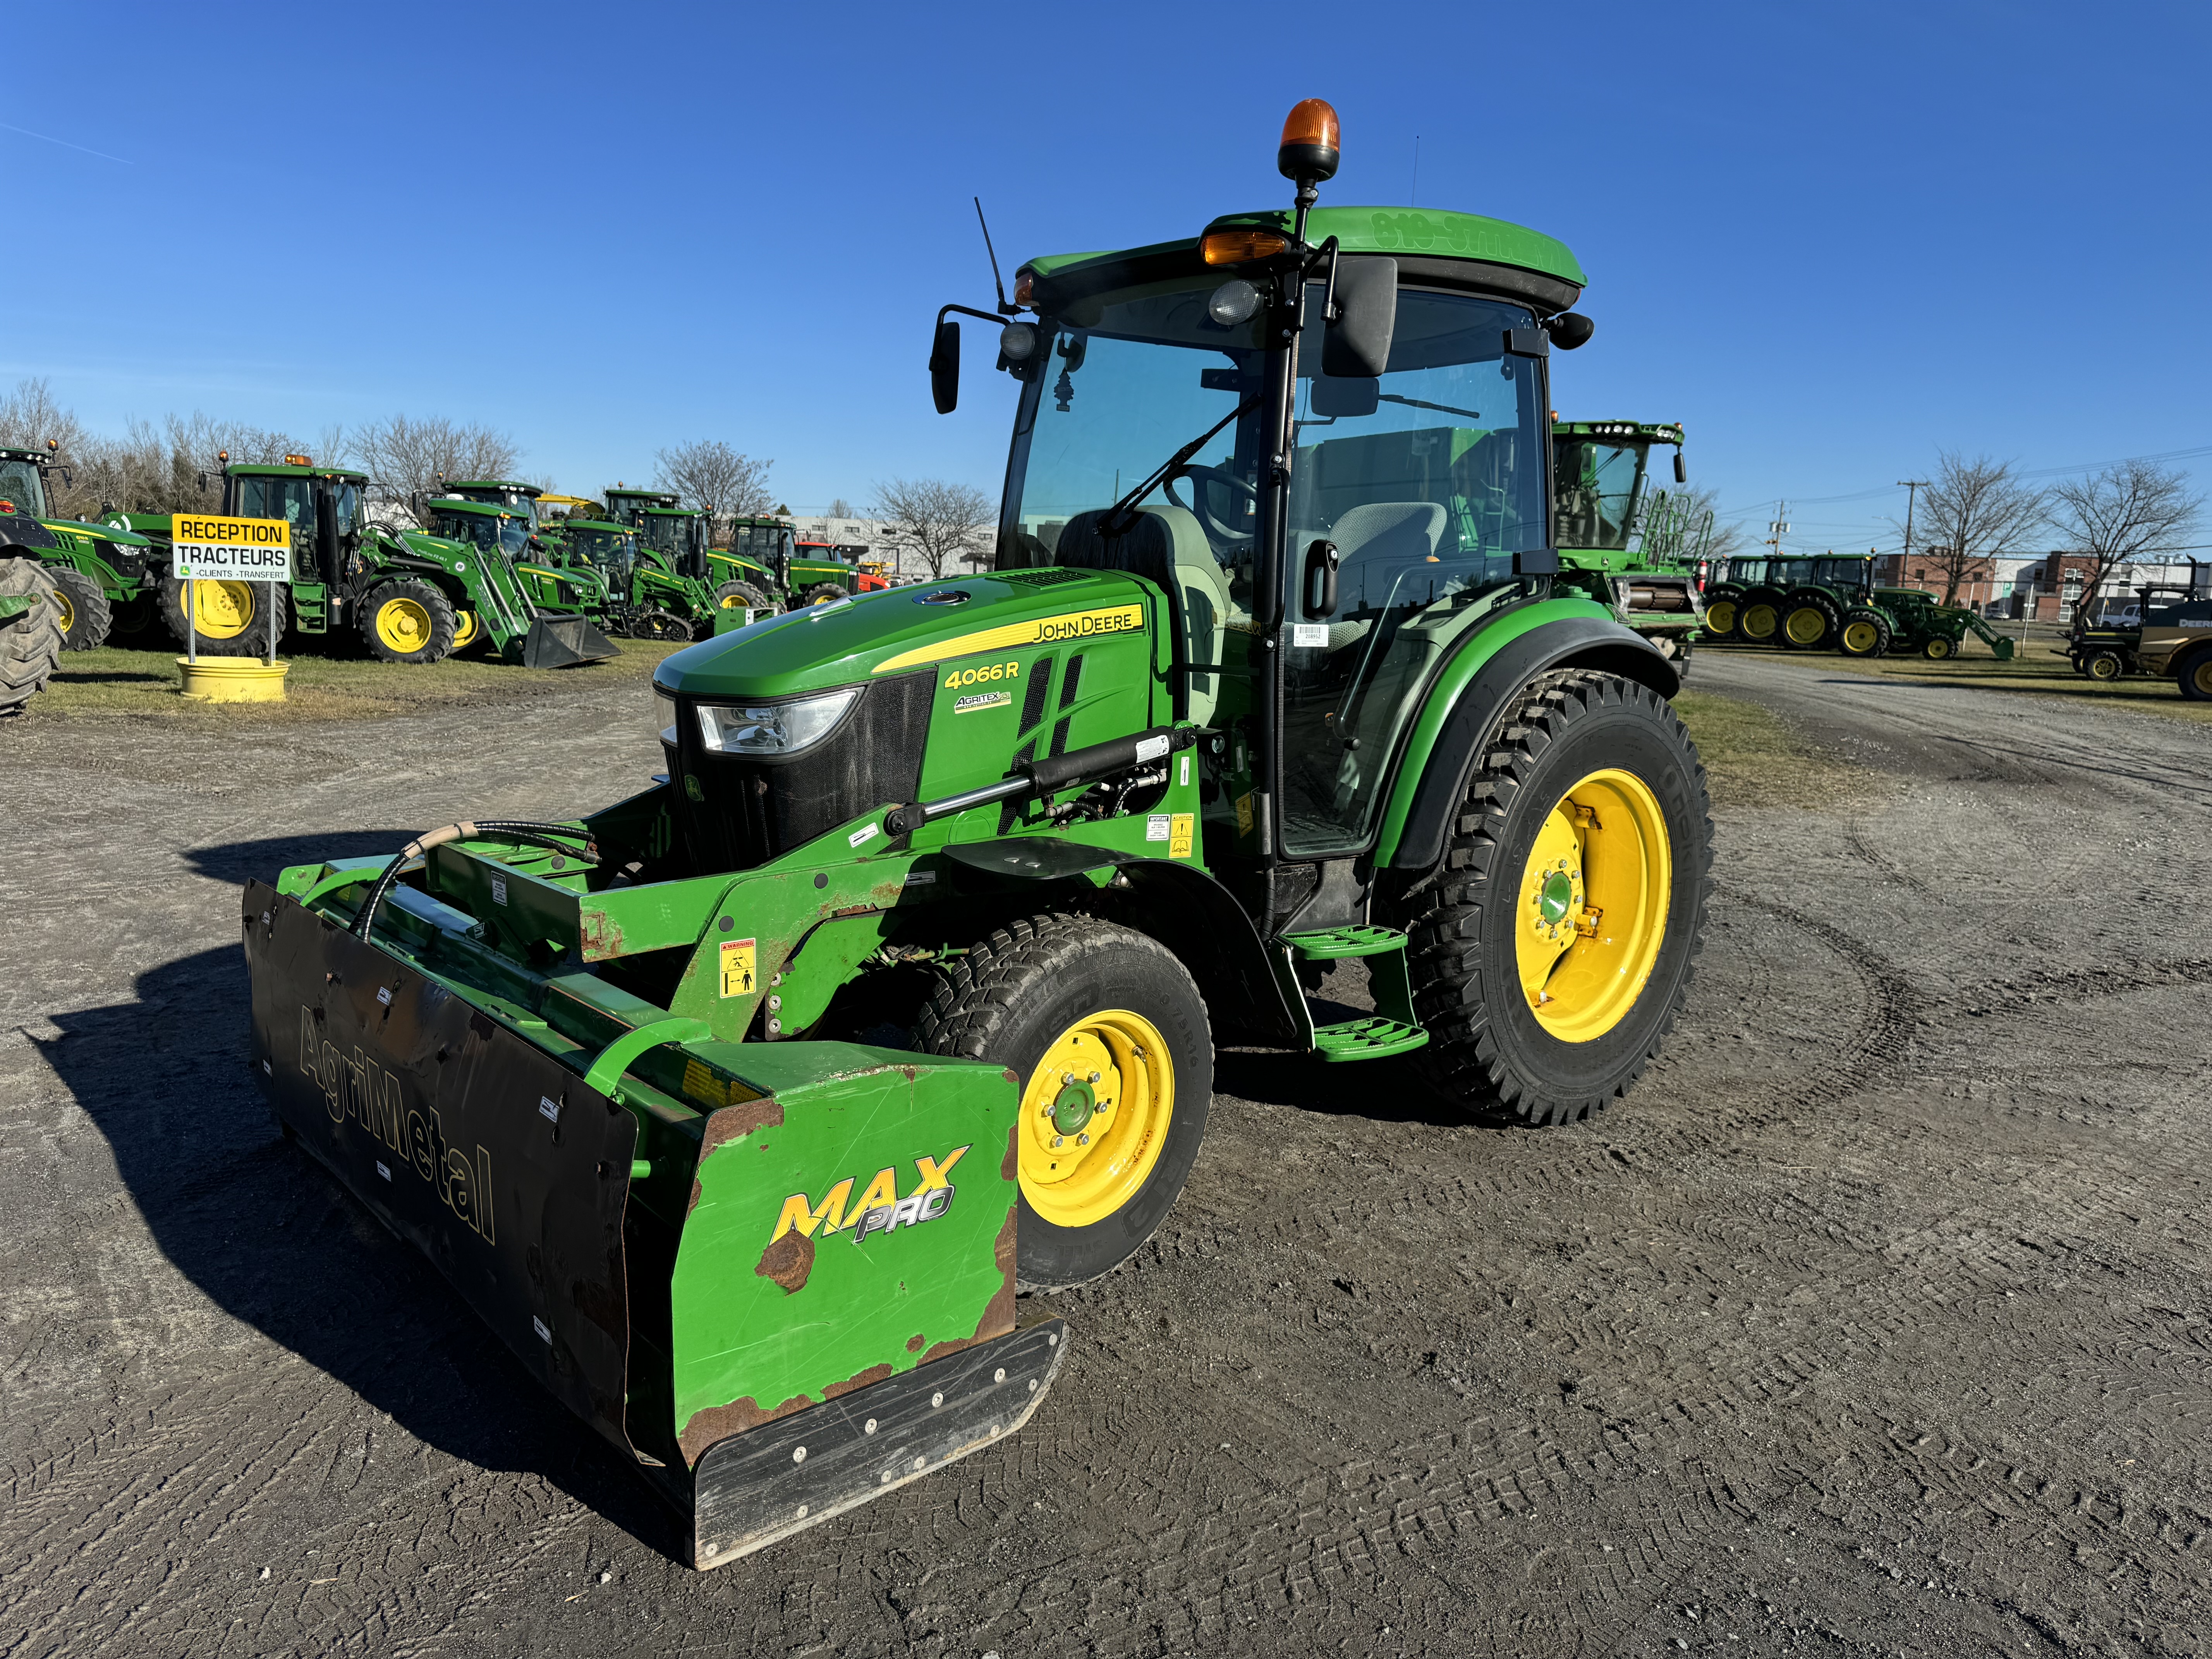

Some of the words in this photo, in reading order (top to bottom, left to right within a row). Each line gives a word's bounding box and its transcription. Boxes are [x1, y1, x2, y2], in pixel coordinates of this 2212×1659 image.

[178, 546, 285, 567] TRACTEURS
[196, 569, 232, 577] -CLIENTS
[236, 570, 285, 579] -TRANSFERT
[1033, 621, 1078, 641] JOHN
[1082, 613, 1132, 633] DEERE
[2179, 619, 2212, 627] DEER
[945, 664, 1003, 690] 4066
[1006, 661, 1019, 679] R
[955, 692, 999, 706] AGRITEX
[727, 941, 753, 949] WARNING
[301, 1004, 495, 1246] AgriMetal
[769, 1143, 974, 1245] MAX
[853, 1185, 955, 1244] PRO
